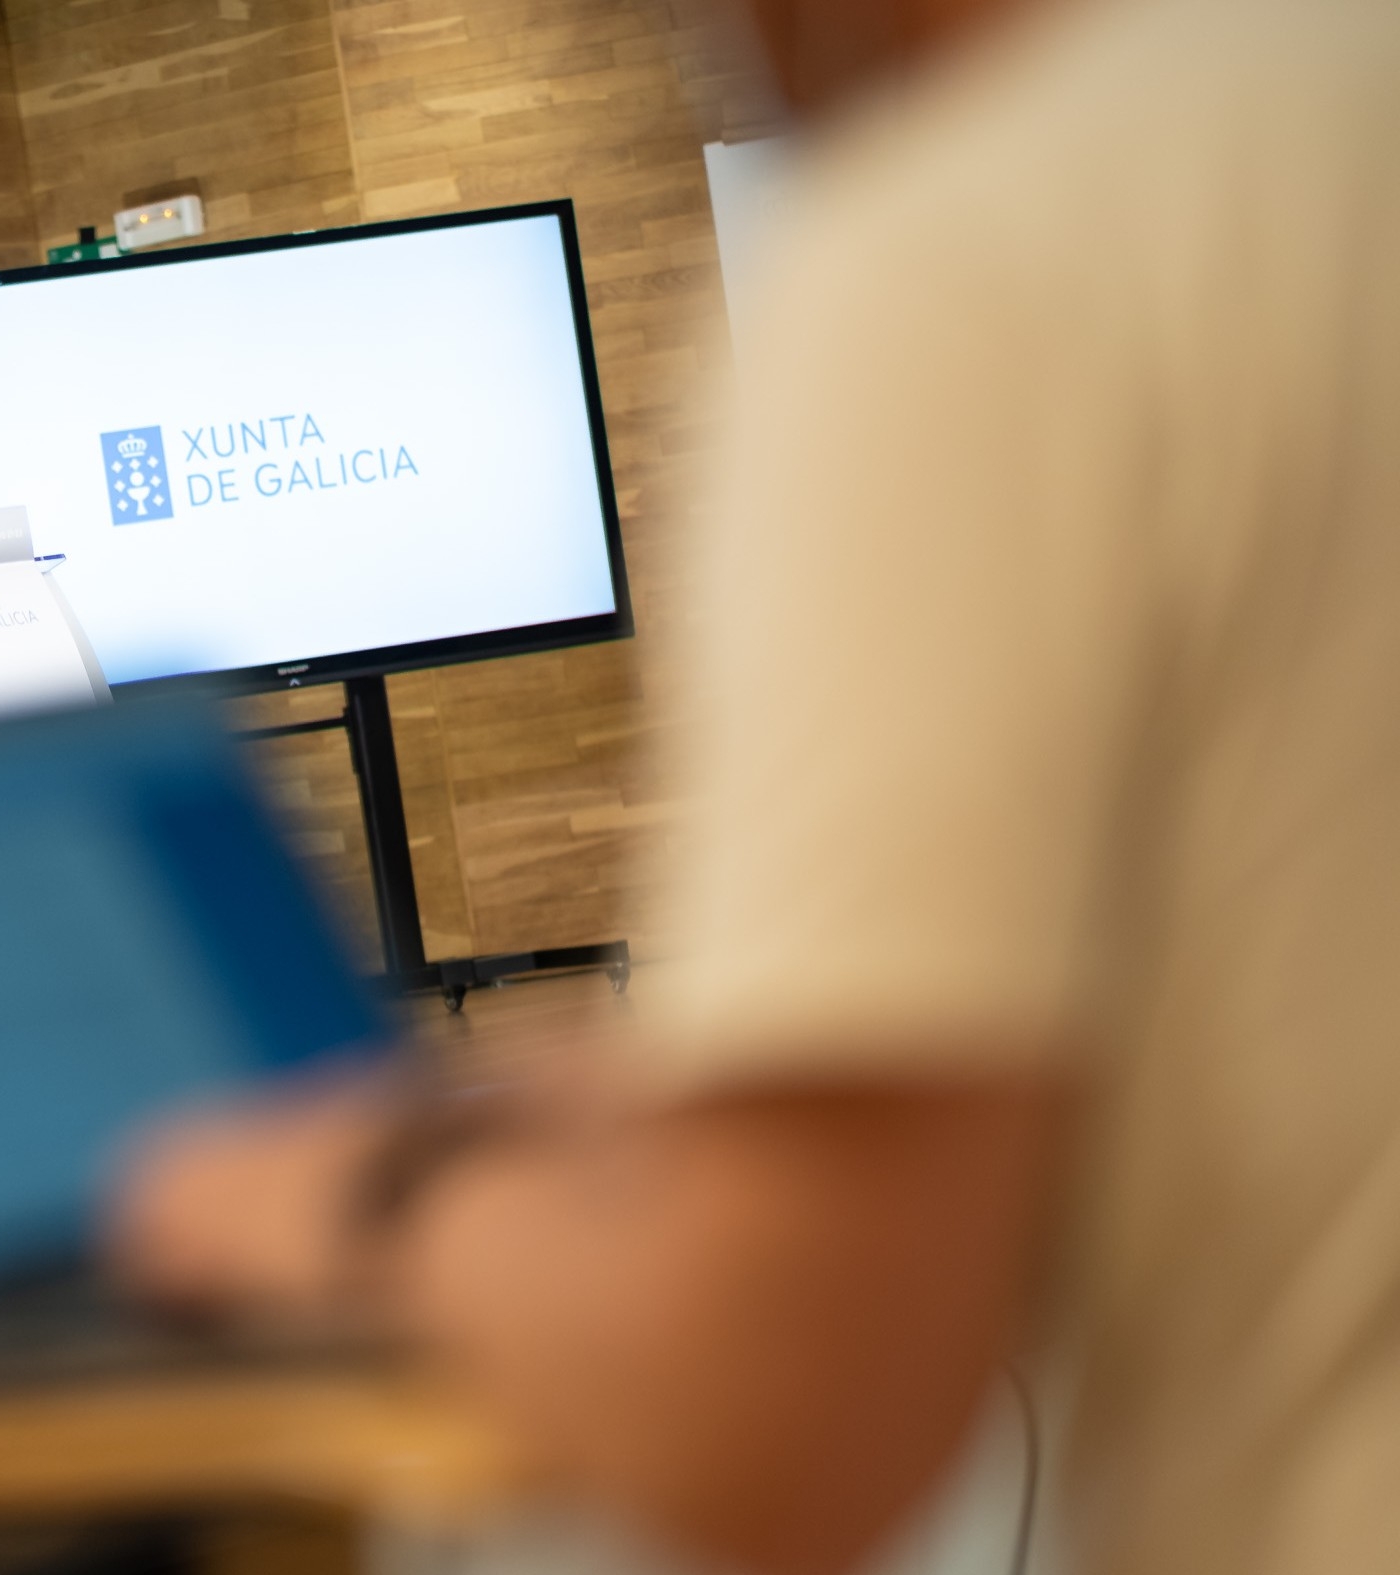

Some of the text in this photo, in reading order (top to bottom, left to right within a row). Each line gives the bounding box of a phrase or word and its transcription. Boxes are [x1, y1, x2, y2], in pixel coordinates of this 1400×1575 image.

[182, 413, 325, 462] XUNTA
[186, 445, 419, 507] DE GALICIA
